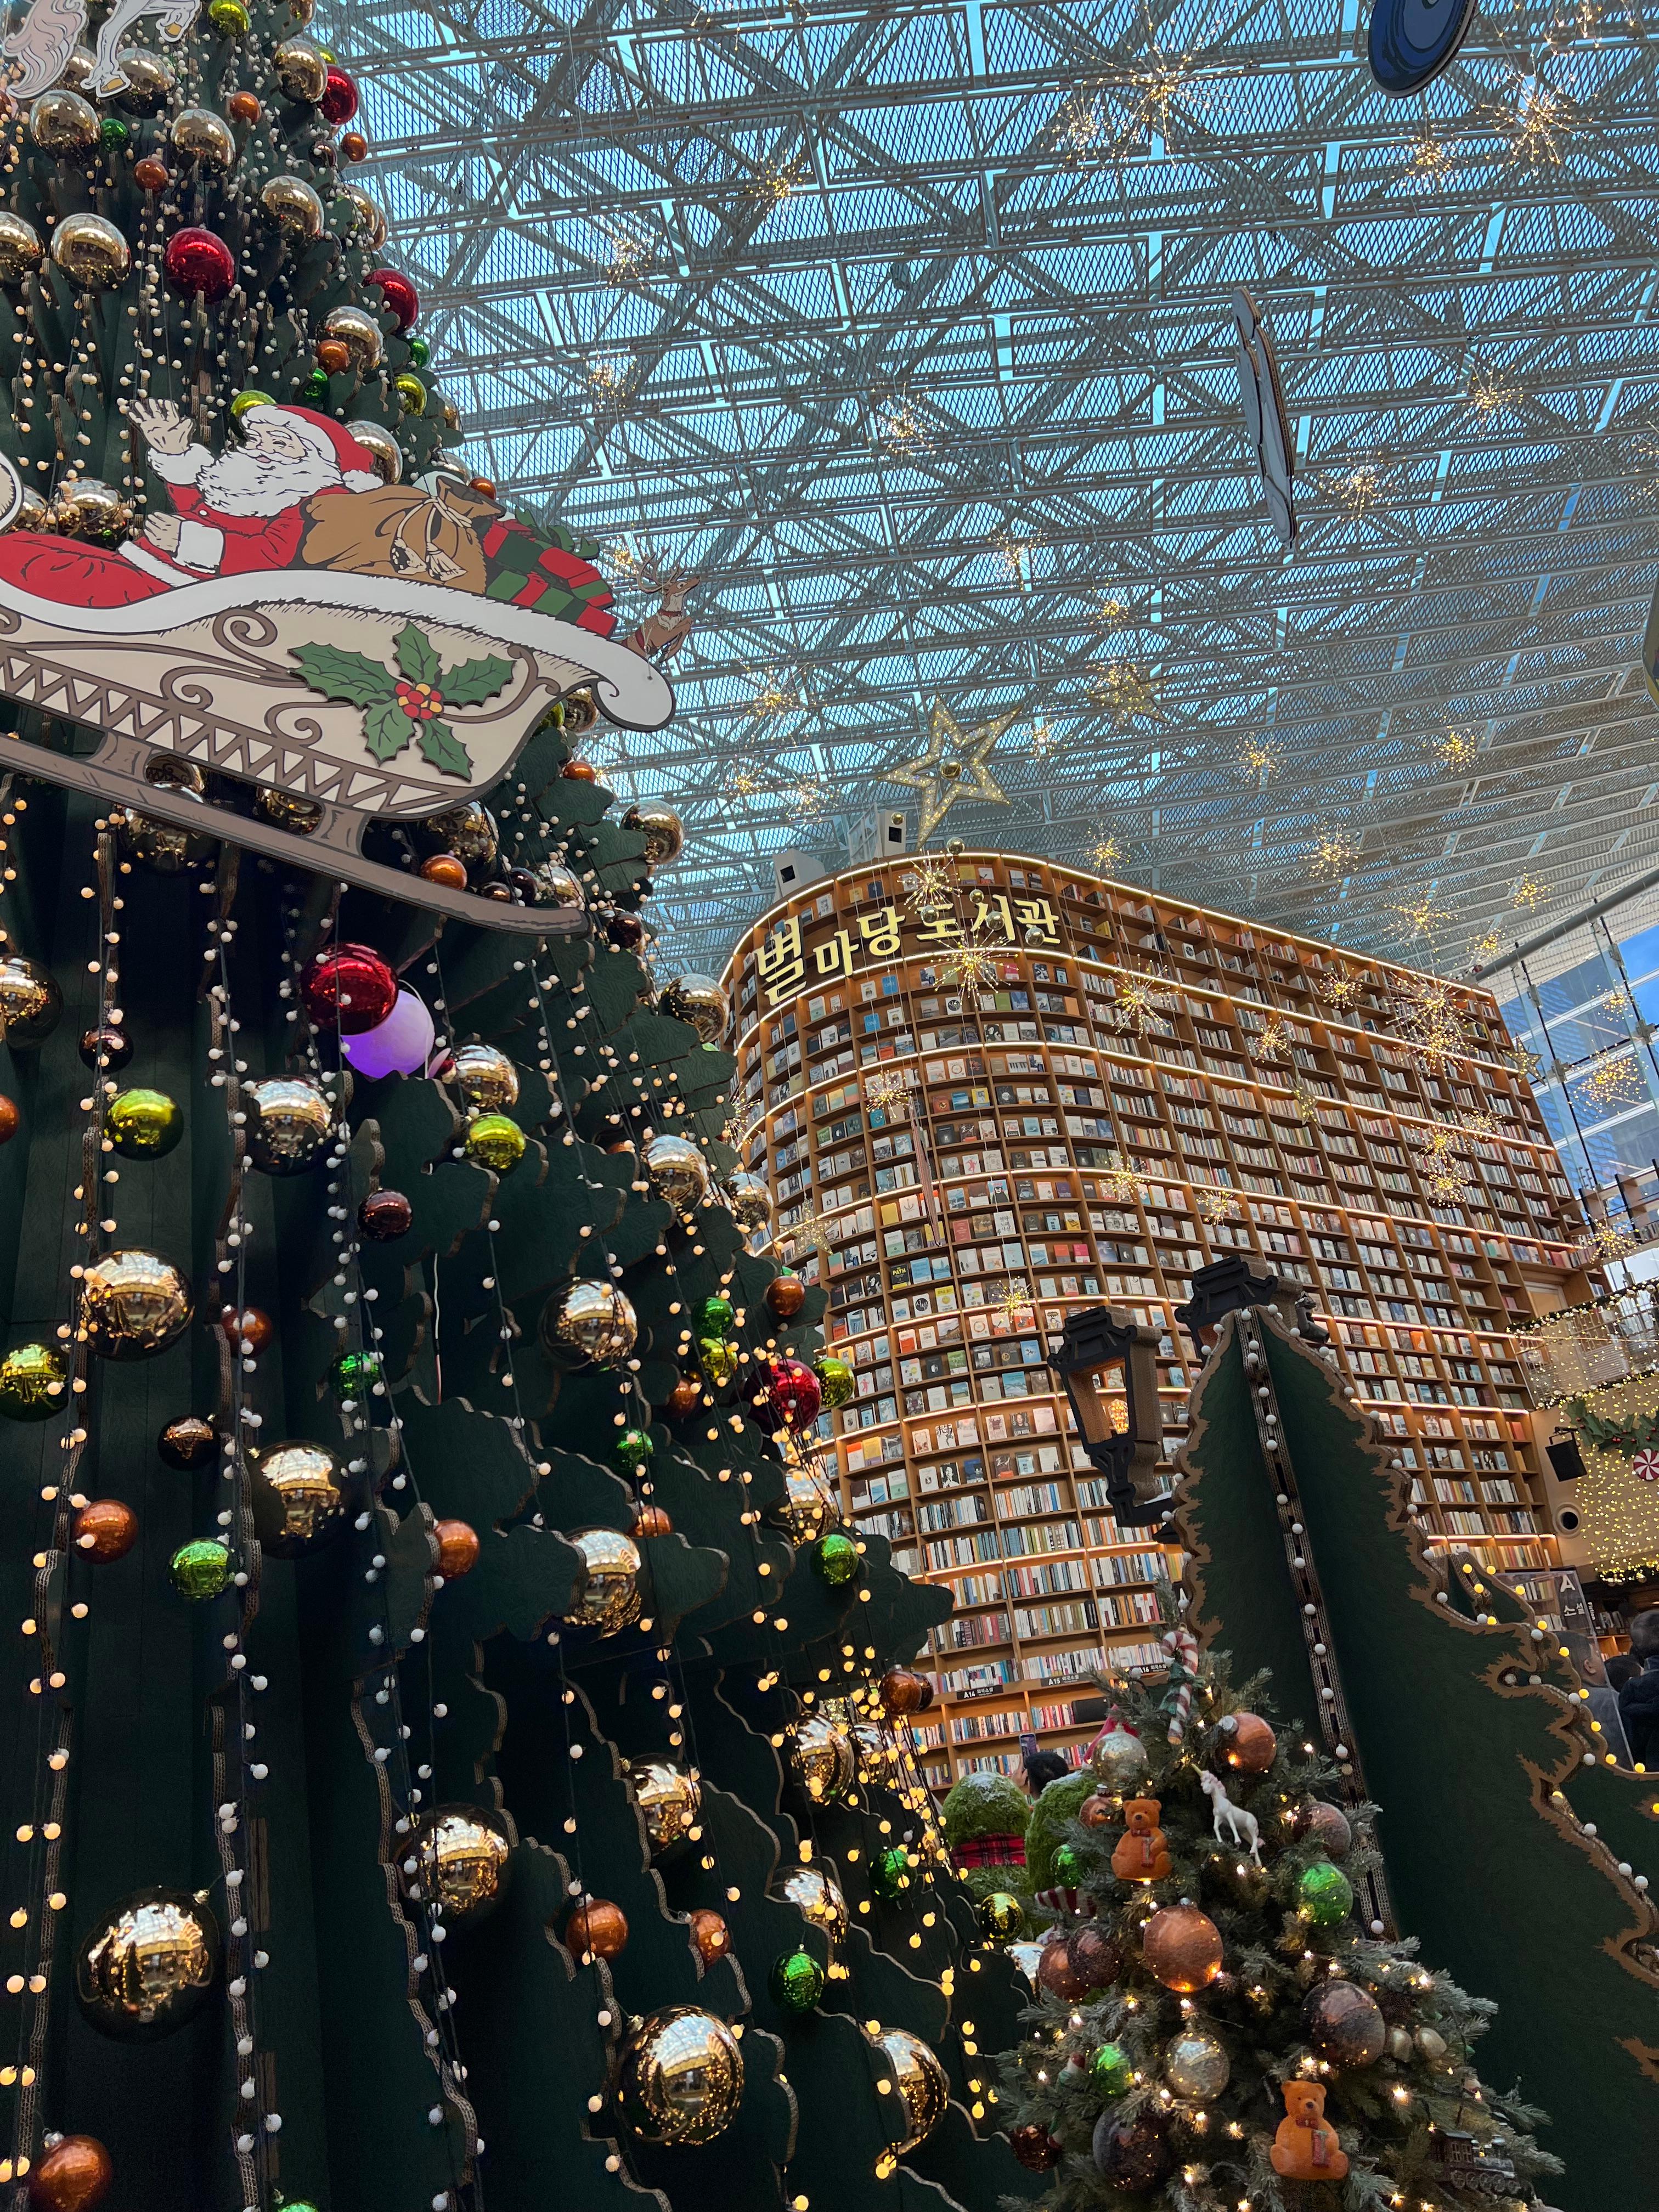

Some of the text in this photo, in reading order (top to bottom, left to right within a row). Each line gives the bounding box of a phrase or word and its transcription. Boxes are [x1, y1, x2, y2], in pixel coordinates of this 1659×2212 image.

[753, 894, 1061, 1006] 별마당 도서관
[892, 1267, 906, 1276] PATH
[1560, 1575, 1576, 1593] A
[1564, 1602, 1585, 1617] 소설
[1587, 1602, 1596, 1621] Fiction
